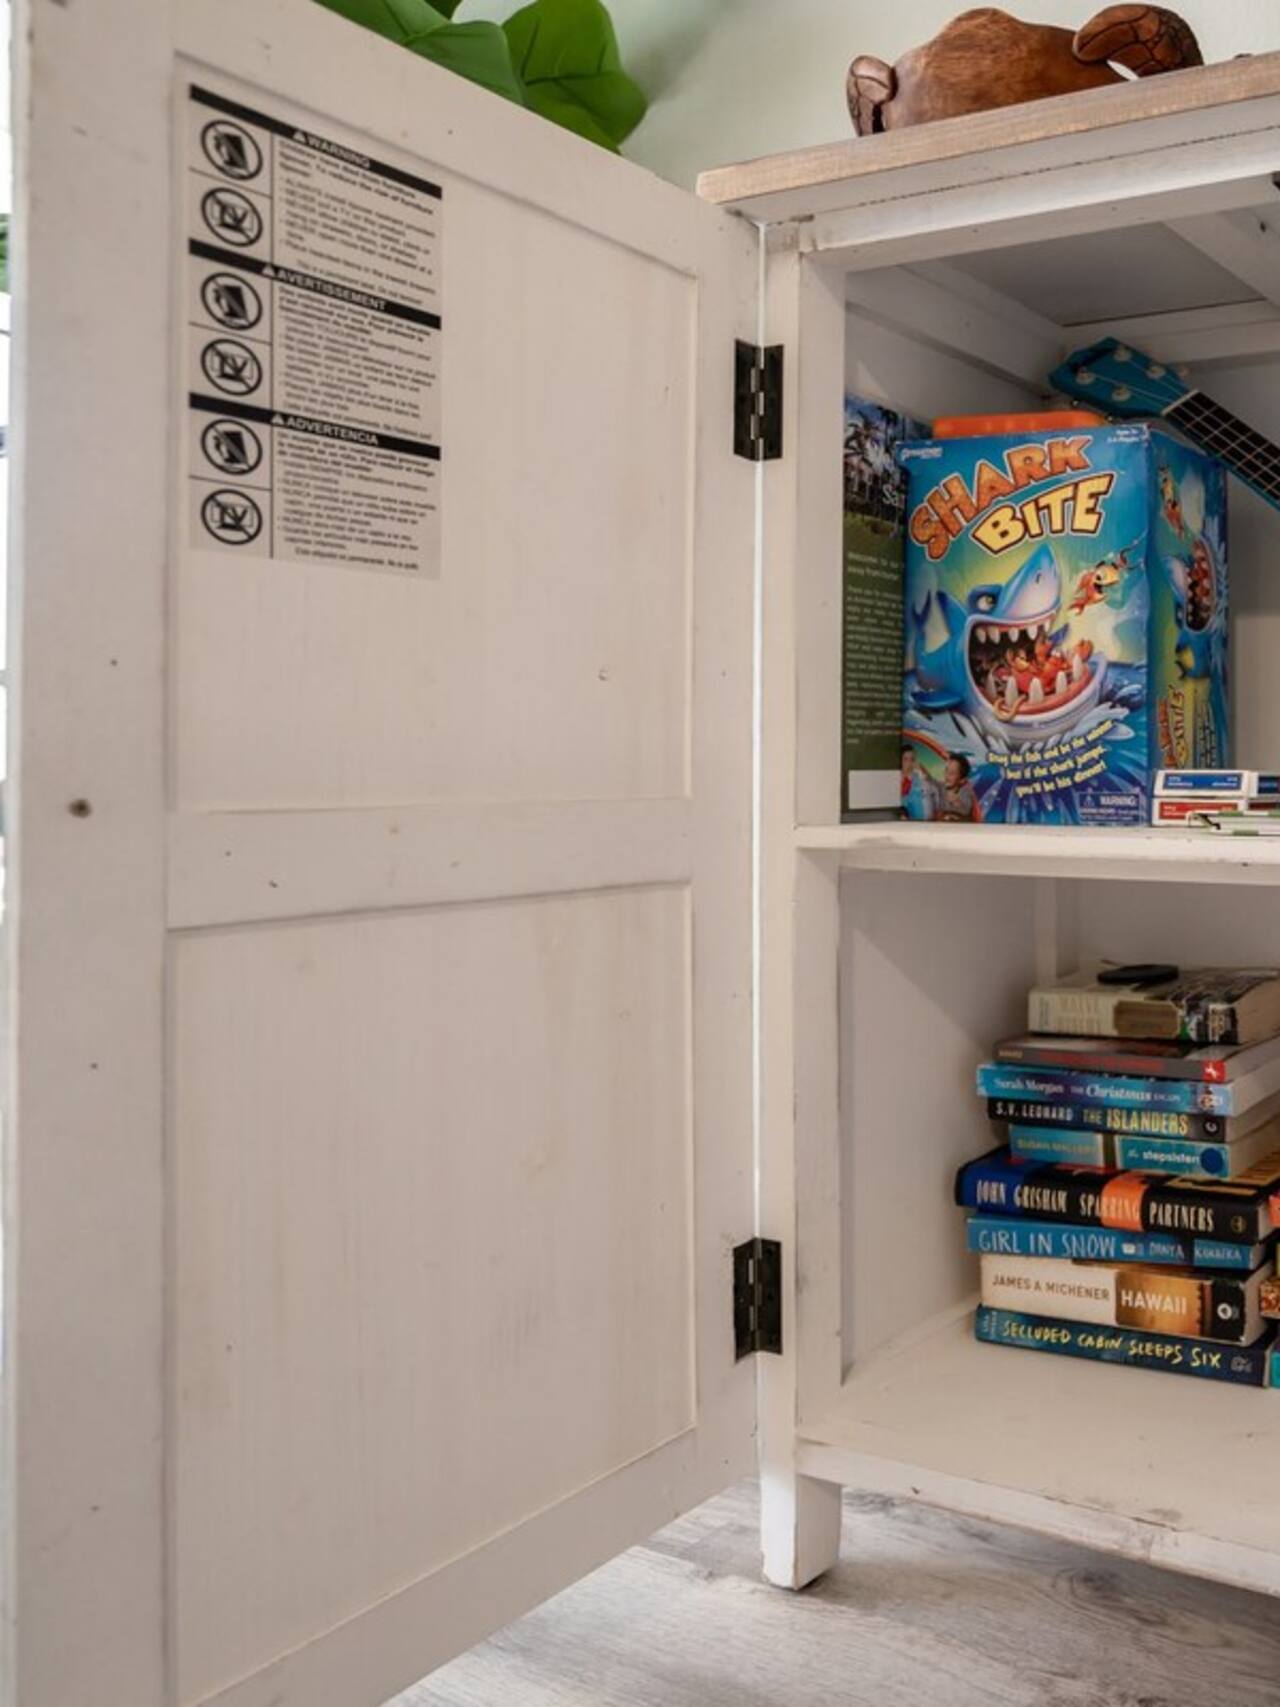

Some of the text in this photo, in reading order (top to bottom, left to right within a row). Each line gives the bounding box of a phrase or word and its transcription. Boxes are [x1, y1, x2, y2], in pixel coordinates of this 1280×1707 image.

[286, 416, 379, 445] ADVERTENCIA
[909, 435, 1093, 560] SHARK
[971, 471, 1115, 554] BITE
[1086, 1083, 1152, 1101] Christmas
[1021, 1103, 1074, 1121] LEONARD
[1106, 1108, 1190, 1135] ISLANDERS
[976, 1180, 1215, 1233] JOHN GRISHAM SPARRING PARTNERS
[978, 1230, 1021, 1253] GIRL
[1029, 1233, 1053, 1255] IN
[1061, 1234, 1117, 1258] SNOW
[991, 1275, 1188, 1315] JAMES A MICHENER HAWAII
[1002, 1319, 1222, 1369] SECLUDED CABIN SLEEPS SIX
